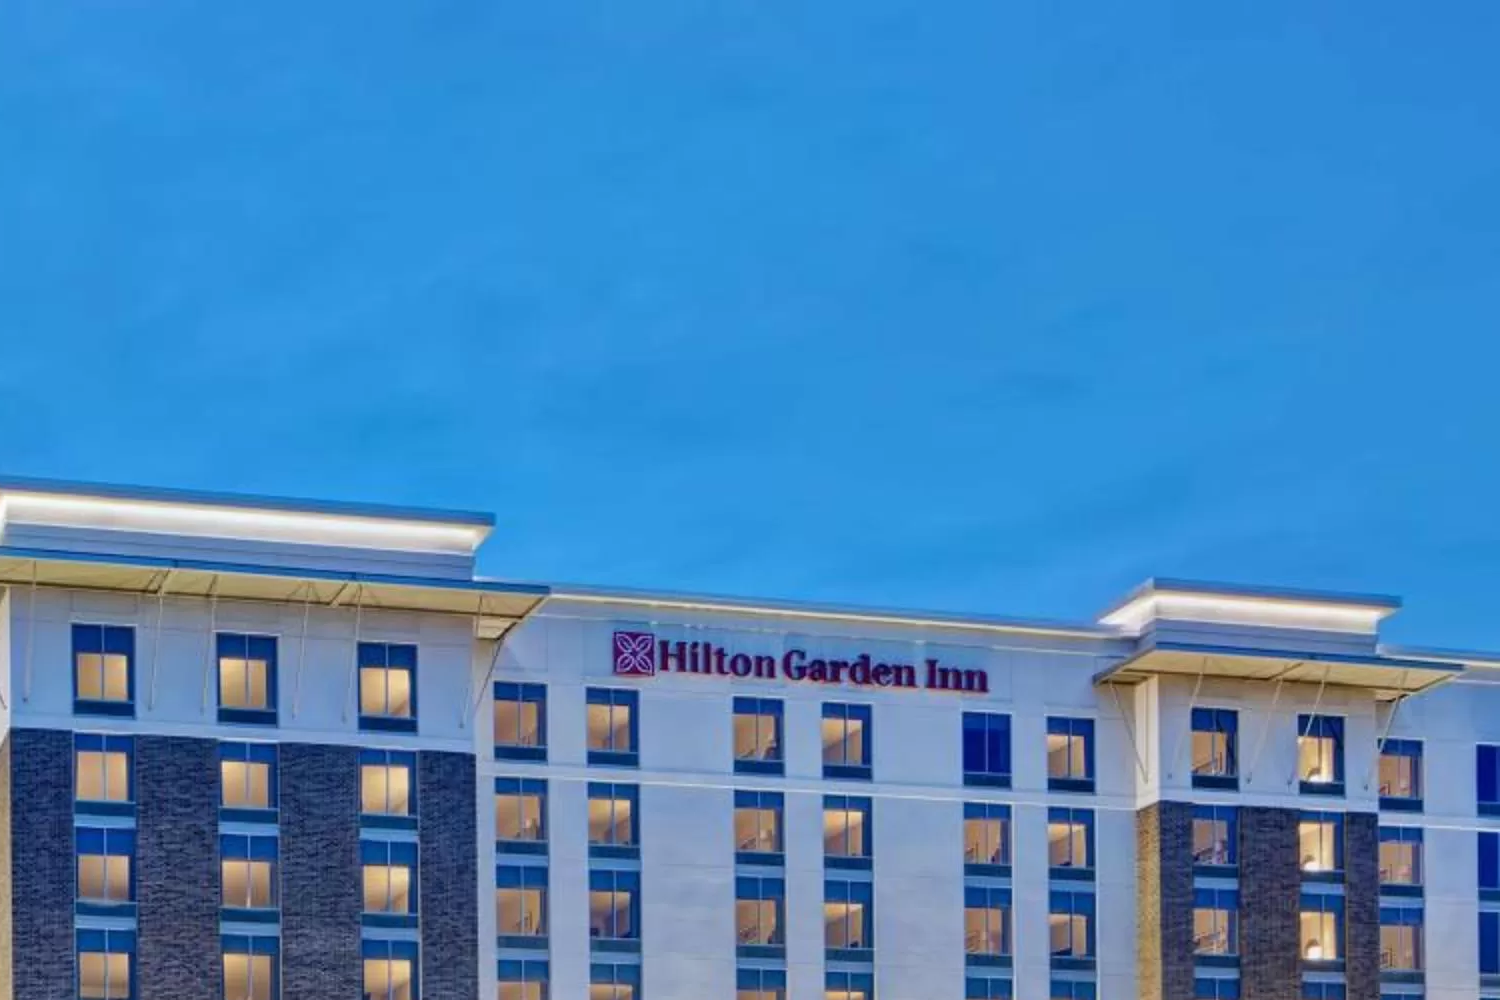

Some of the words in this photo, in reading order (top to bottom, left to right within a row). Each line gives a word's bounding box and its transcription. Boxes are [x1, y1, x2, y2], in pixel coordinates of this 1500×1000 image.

[659, 639, 776, 679] Hilton
[783, 650, 917, 688] Garden
[925, 659, 989, 693] Inn
